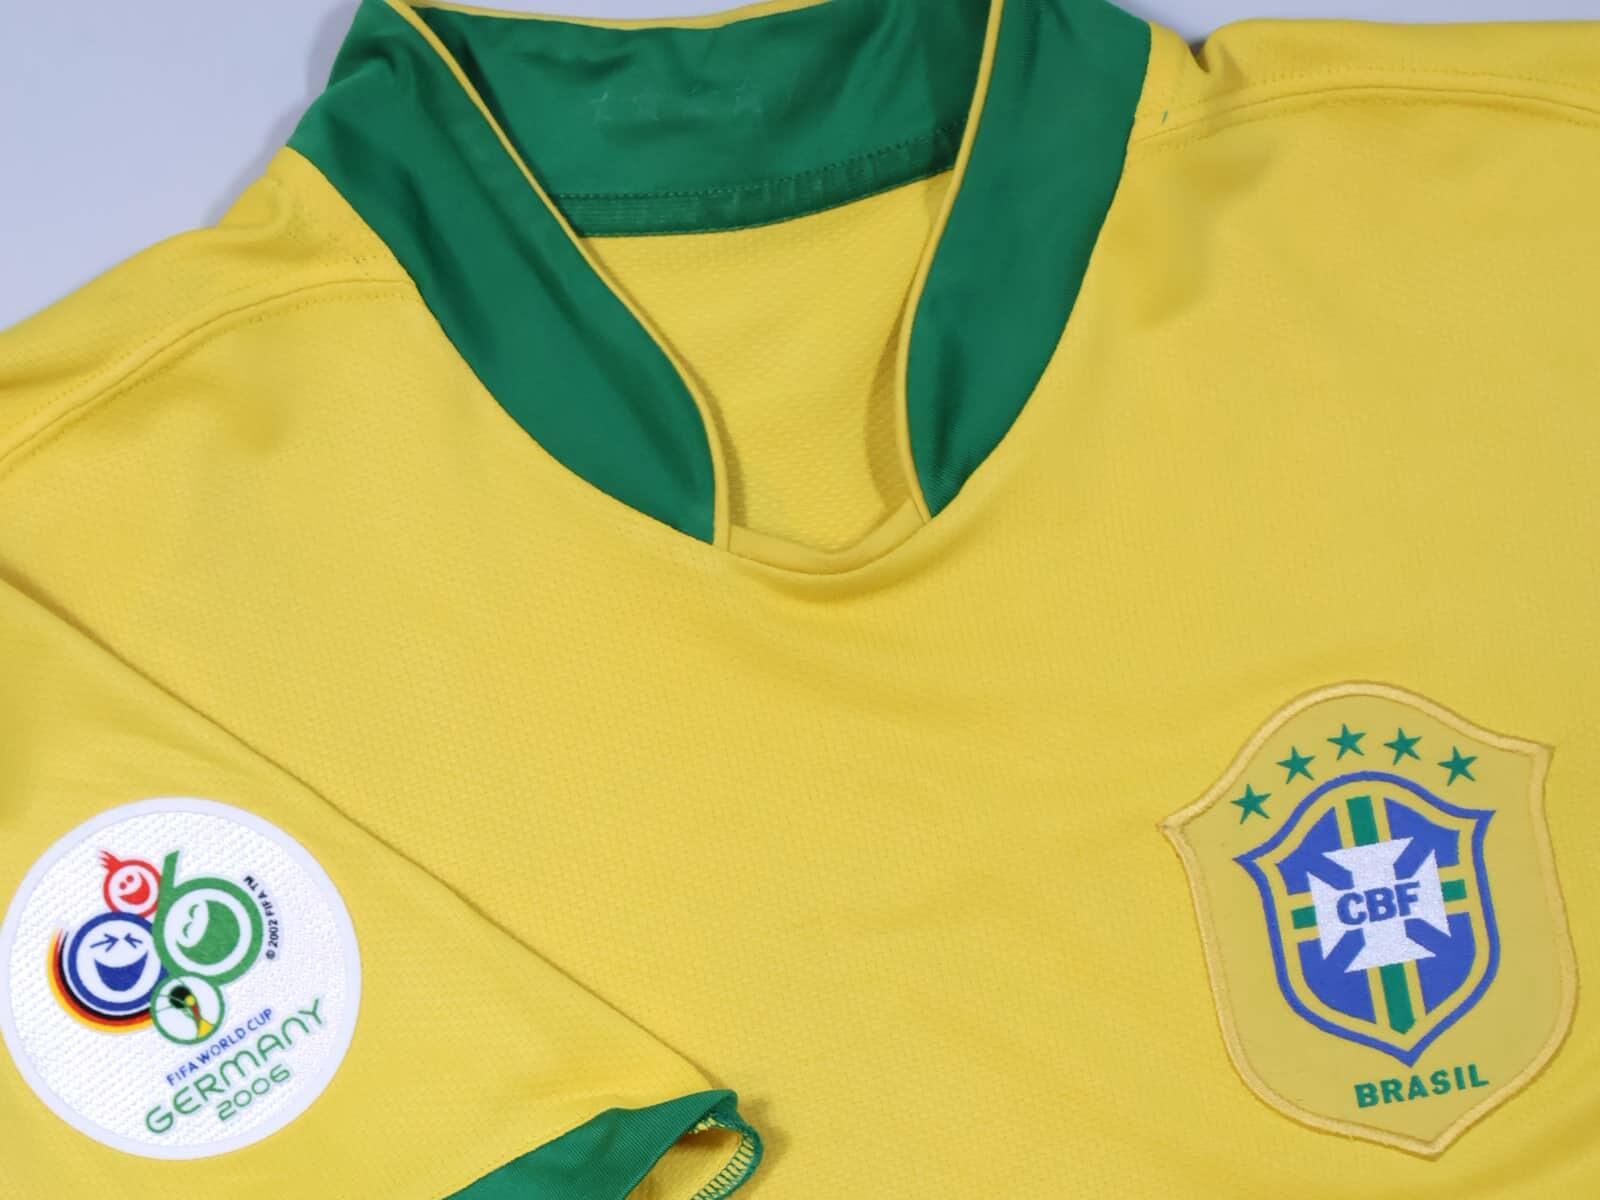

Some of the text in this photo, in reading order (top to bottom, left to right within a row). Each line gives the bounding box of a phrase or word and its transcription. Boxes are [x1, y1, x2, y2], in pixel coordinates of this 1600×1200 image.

[257, 889, 275, 917] FIFA
[1336, 880, 1422, 926] CBF
[268, 919, 279, 948] 2002
[145, 998, 322, 1134] GERMANY
[166, 1008, 273, 1086] FIFA WORLD CUP
[216, 1063, 291, 1121] 2006
[1353, 1063, 1490, 1109] BRASIL
